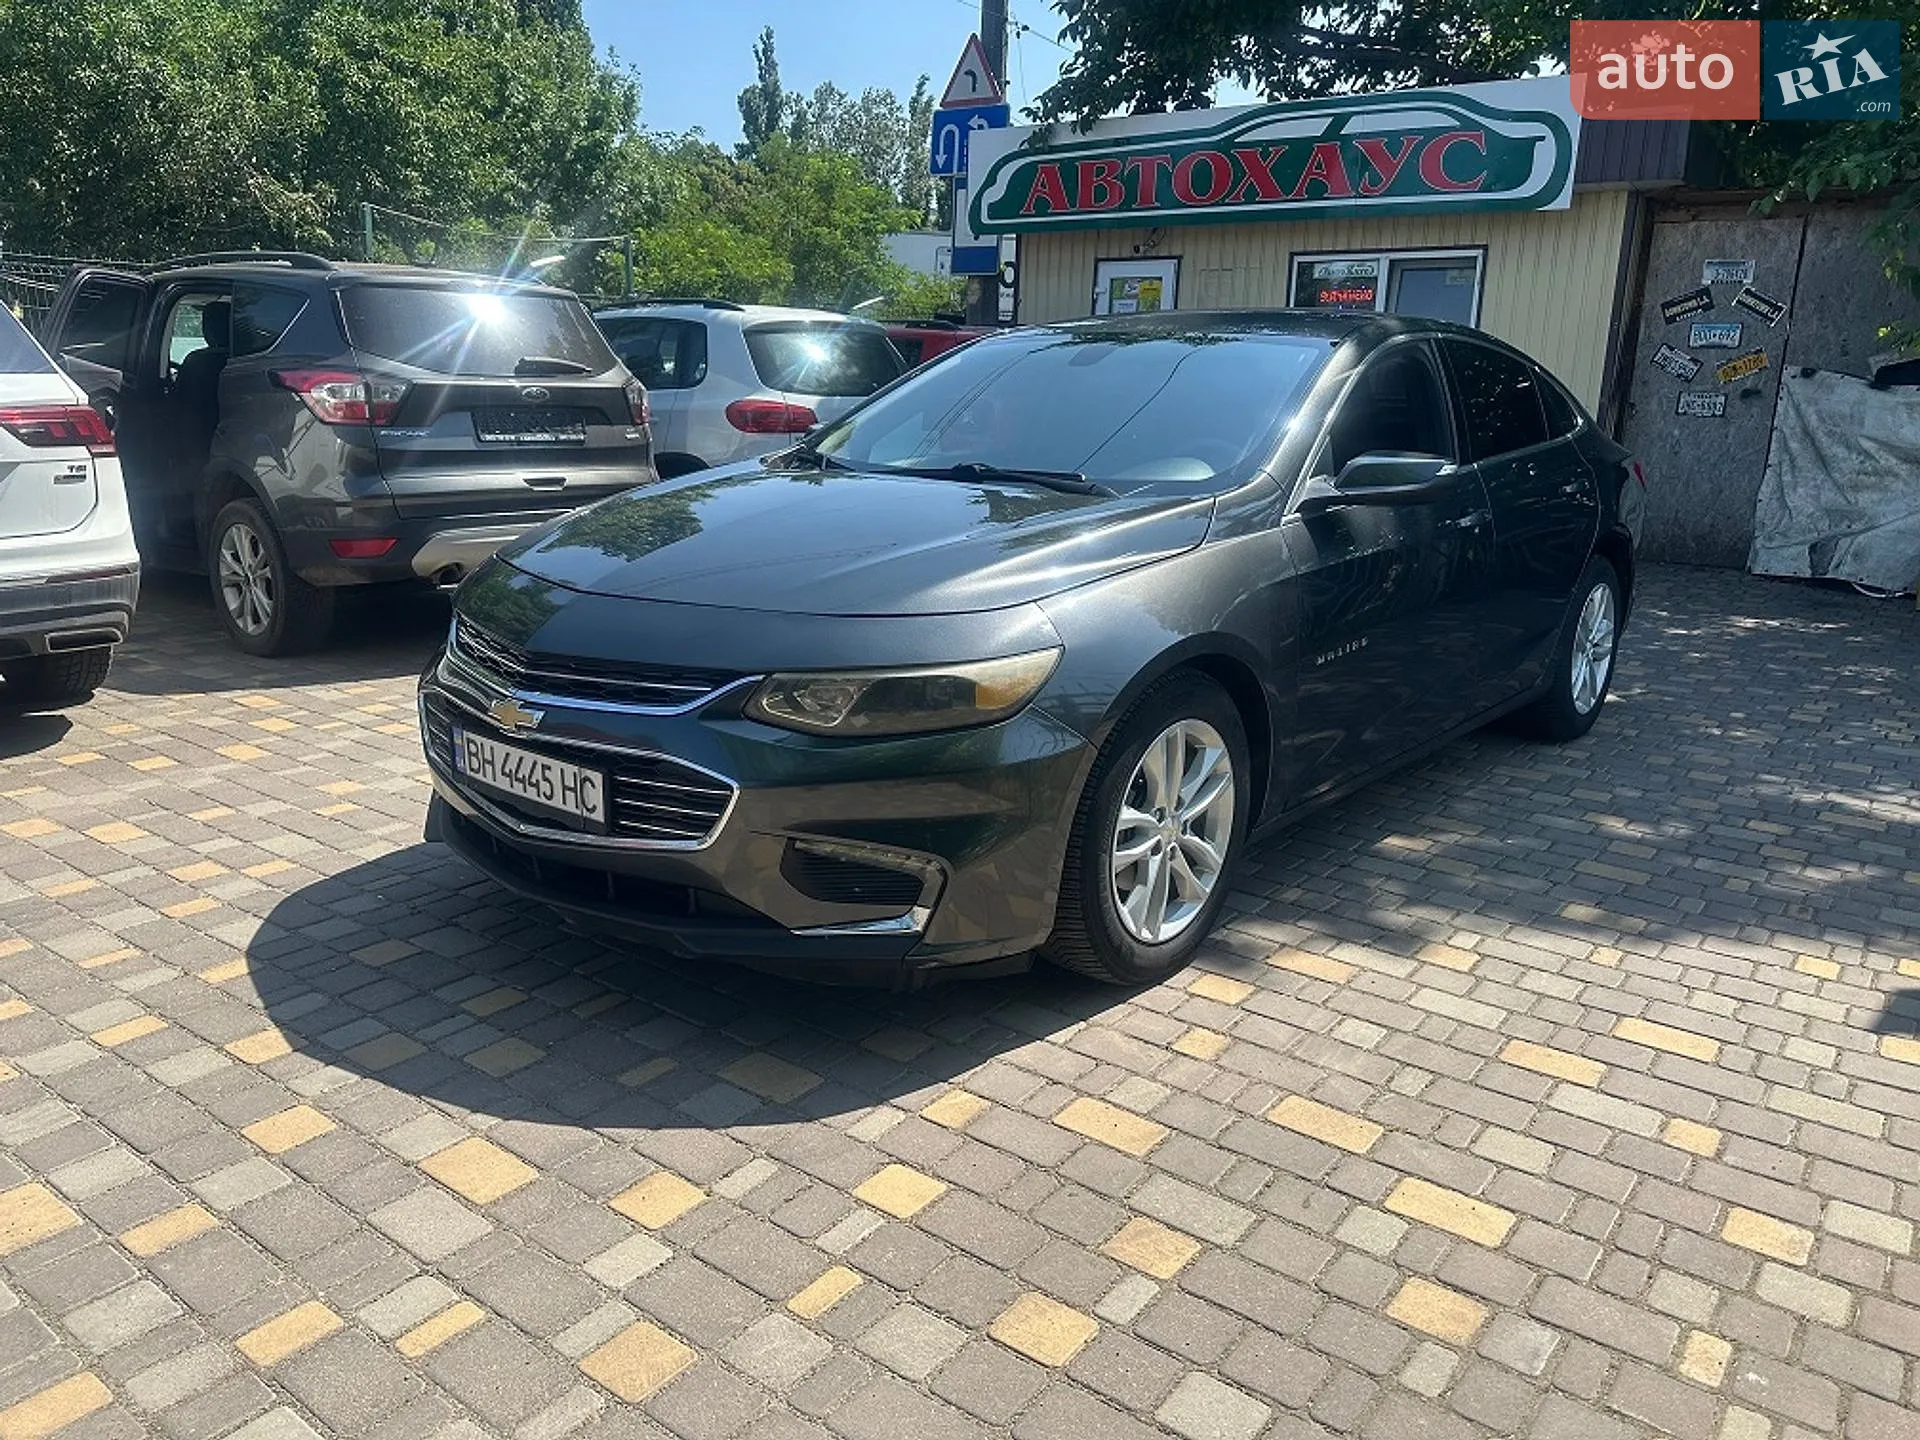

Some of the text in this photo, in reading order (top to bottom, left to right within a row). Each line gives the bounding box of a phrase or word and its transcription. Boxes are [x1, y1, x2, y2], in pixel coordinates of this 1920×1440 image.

[1019, 131, 1488, 215] АВТОХАУС
[466, 737, 597, 814] BH 4445 HC
